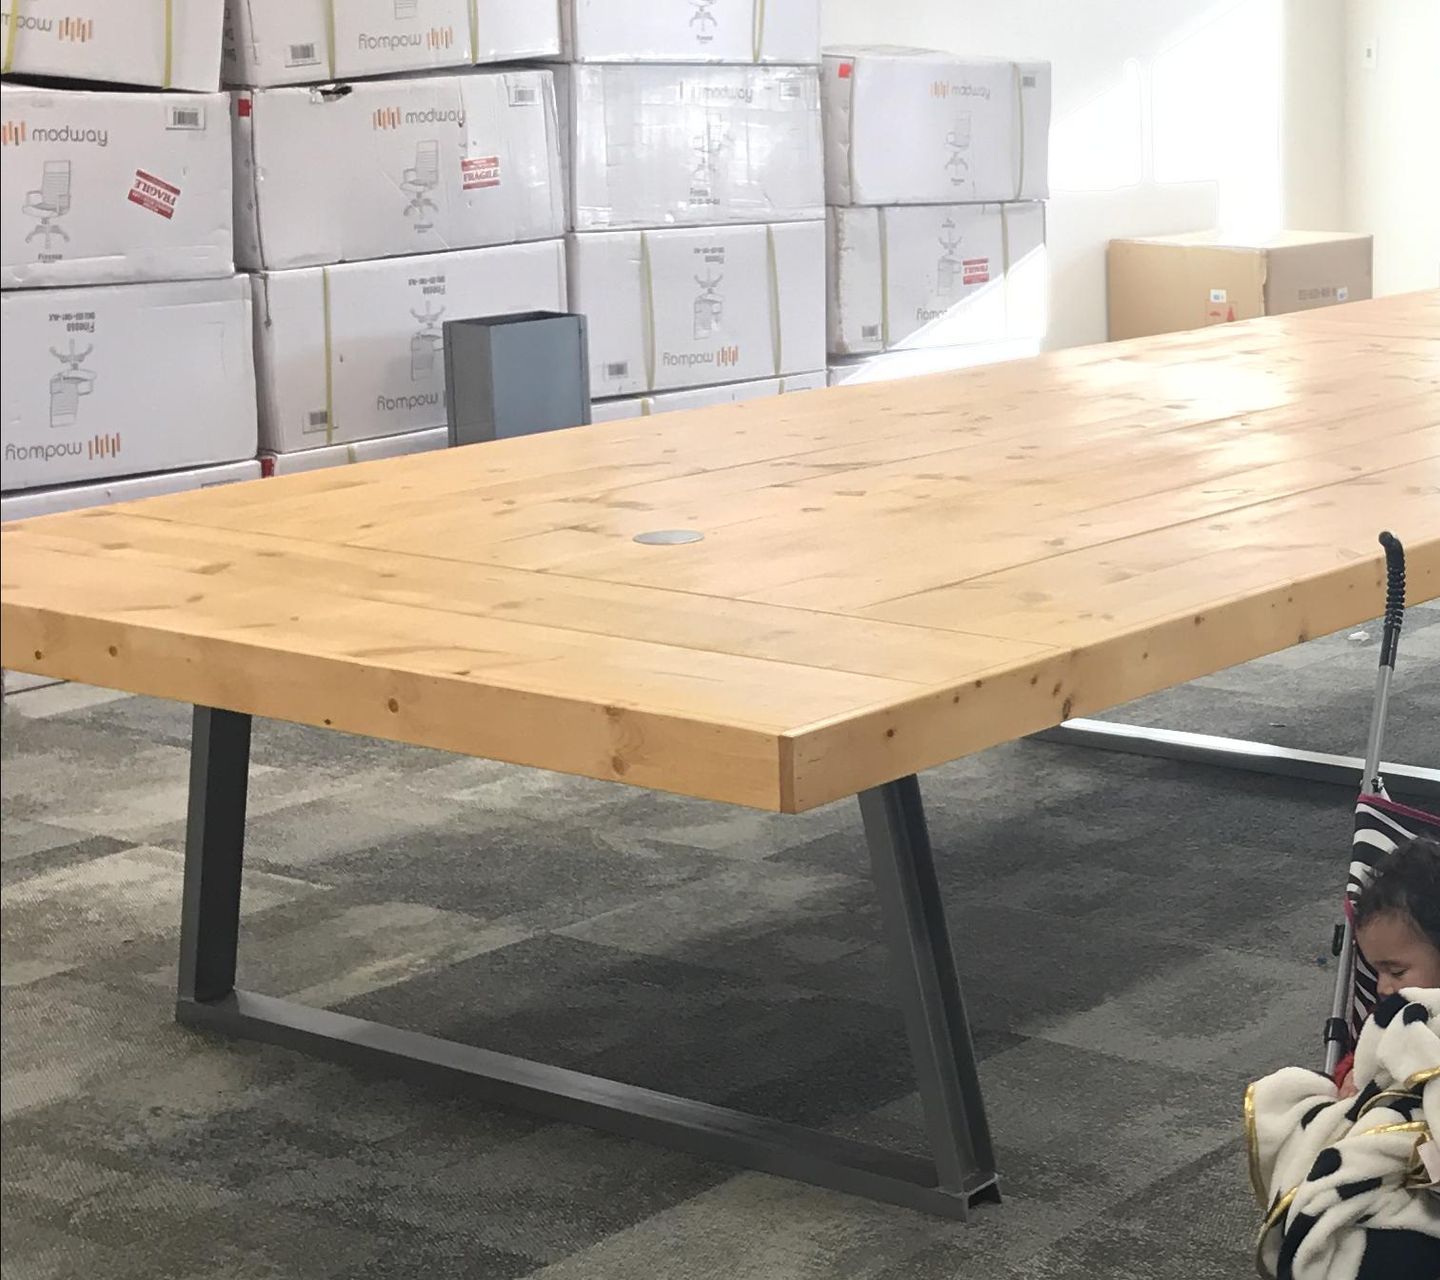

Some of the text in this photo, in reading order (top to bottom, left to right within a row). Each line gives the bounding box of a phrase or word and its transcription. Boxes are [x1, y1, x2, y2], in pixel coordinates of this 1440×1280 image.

[358, 33, 422, 51] modway
[951, 82, 991, 100] modway
[405, 108, 466, 126] modway
[32, 125, 108, 147] modway
[463, 170, 499, 182] FRAGILE
[135, 178, 176, 206] FRAGILE
[663, 350, 714, 367] modway
[377, 392, 438, 410] modway
[5, 441, 82, 461] modway
